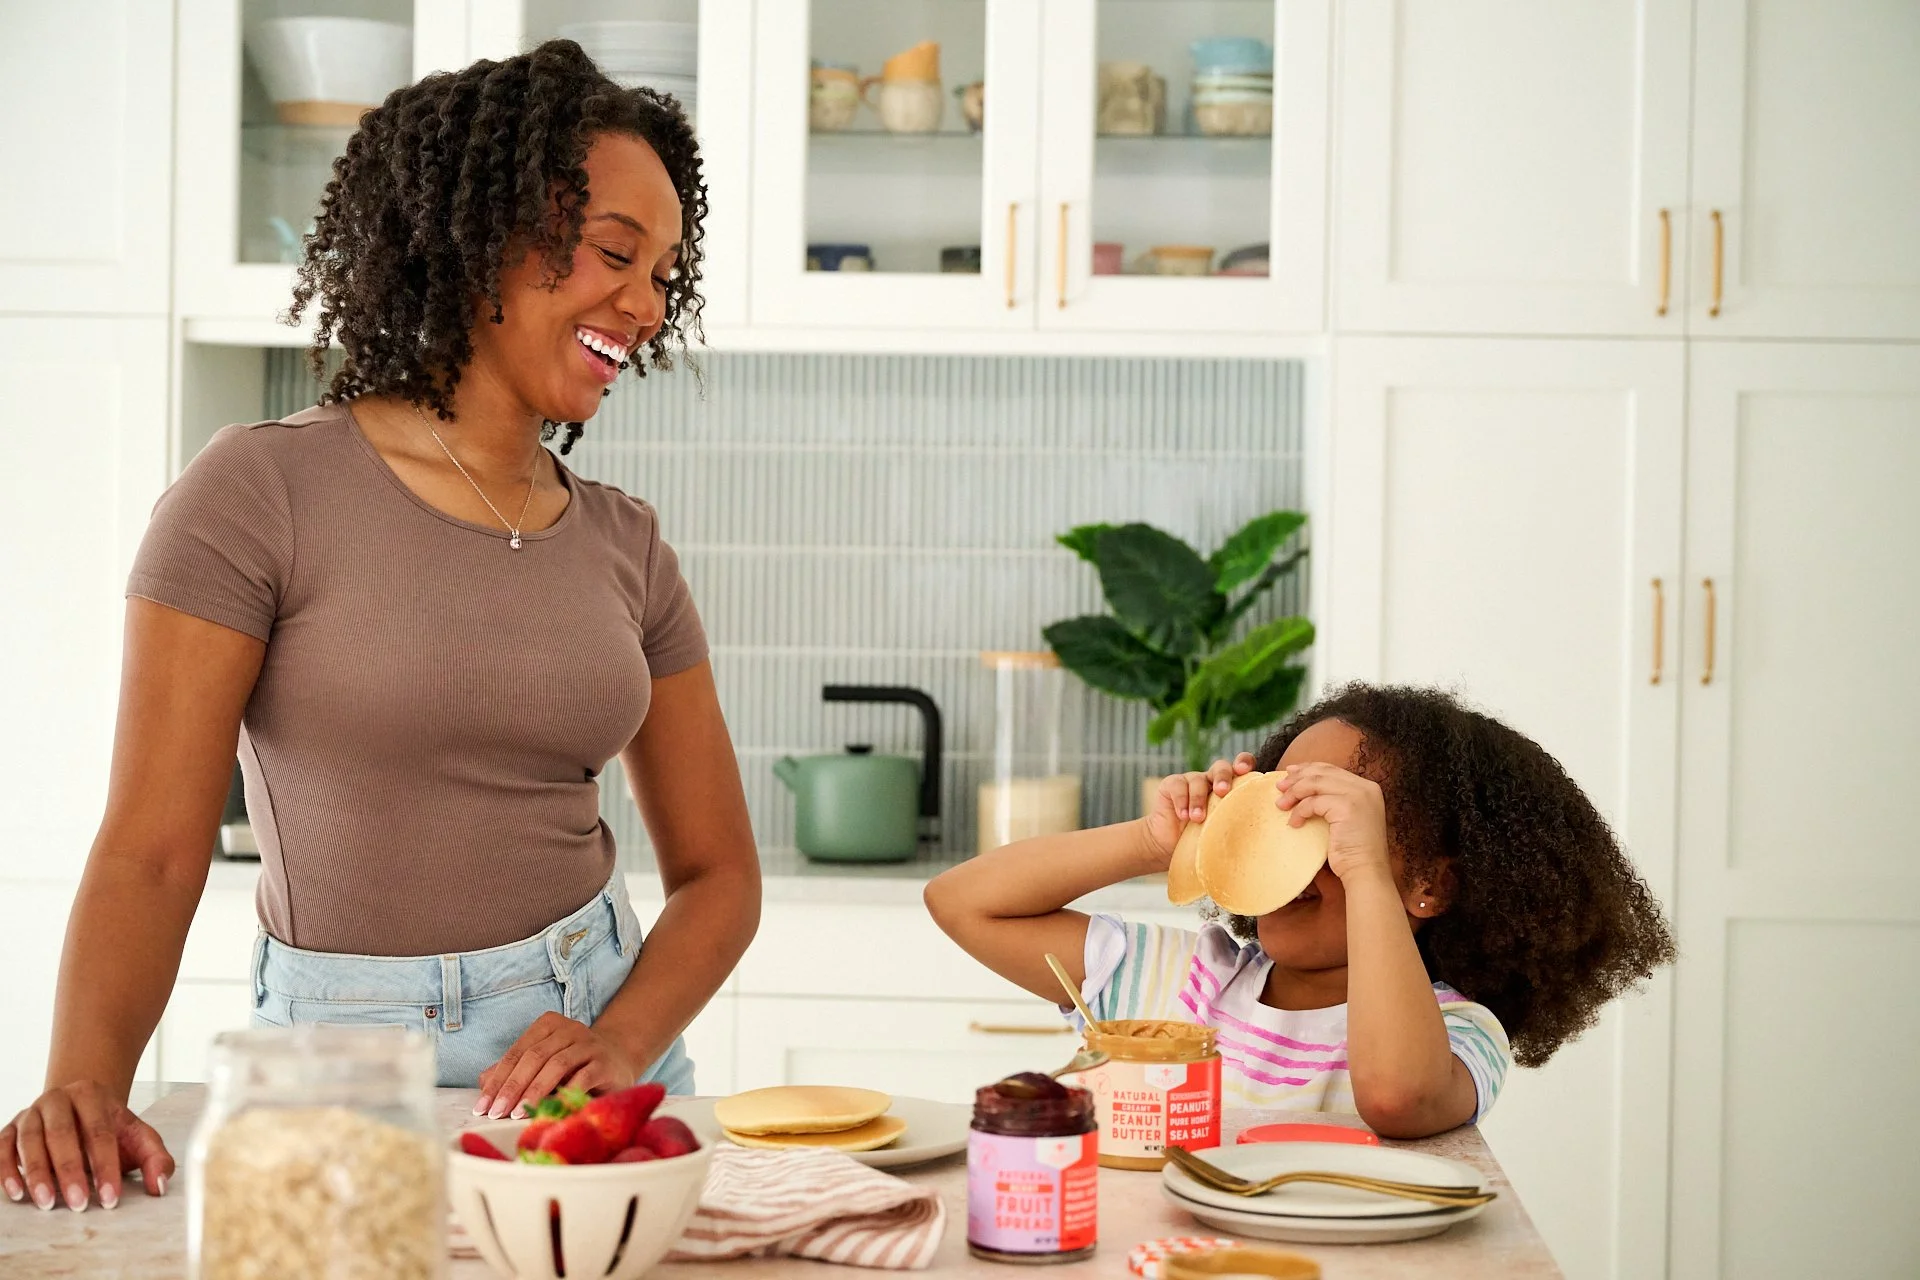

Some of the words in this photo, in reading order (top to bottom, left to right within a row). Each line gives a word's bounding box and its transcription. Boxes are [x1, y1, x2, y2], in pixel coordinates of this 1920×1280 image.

[1113, 1091, 1160, 1101] NATURAL
[1170, 1101, 1210, 1114] PEANUTS
[1112, 1114, 1161, 1126] PEANUT
[1170, 1118, 1189, 1126] PURE
[1112, 1128, 1161, 1140] BUTTER
[1170, 1130, 1189, 1140] SEA
[1191, 1127, 1209, 1139] SALT
[996, 1196, 1052, 1214] FRUIT
[996, 1216, 1053, 1230] SPREAD
